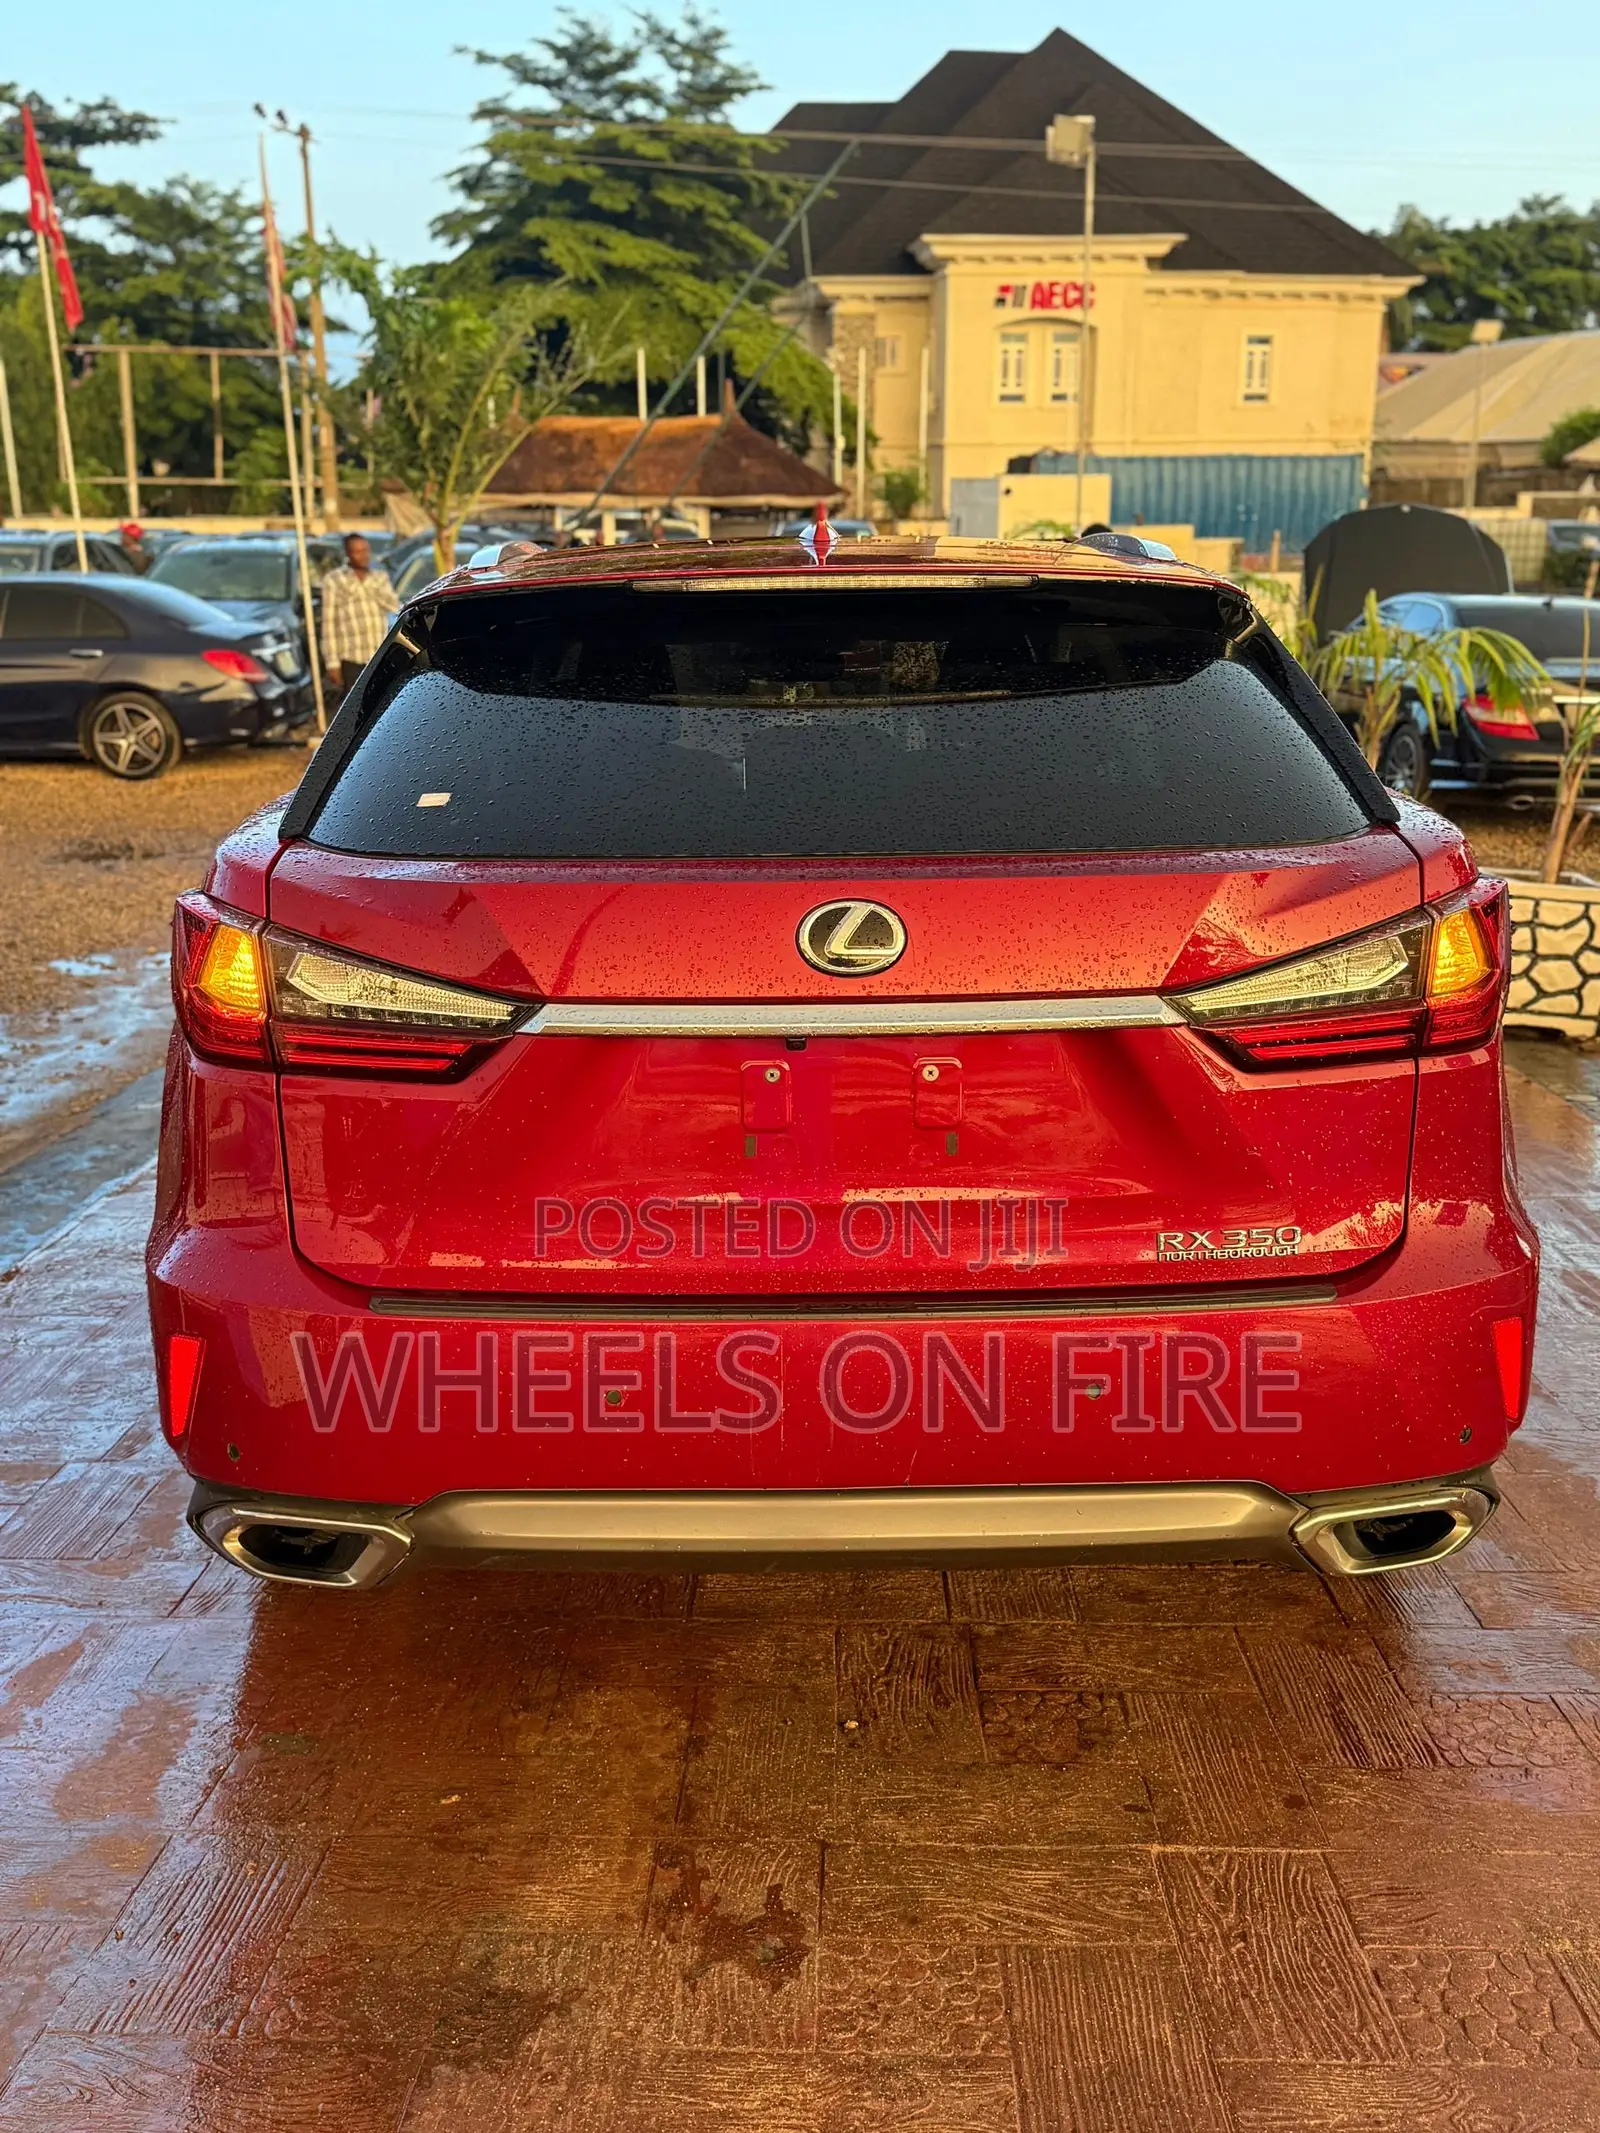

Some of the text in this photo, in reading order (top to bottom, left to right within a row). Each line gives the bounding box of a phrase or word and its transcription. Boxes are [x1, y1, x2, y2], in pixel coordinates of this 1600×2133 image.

[1157, 1226, 1302, 1251] RX 350
[1157, 1246, 1299, 1263] NORTHBOROUGH
